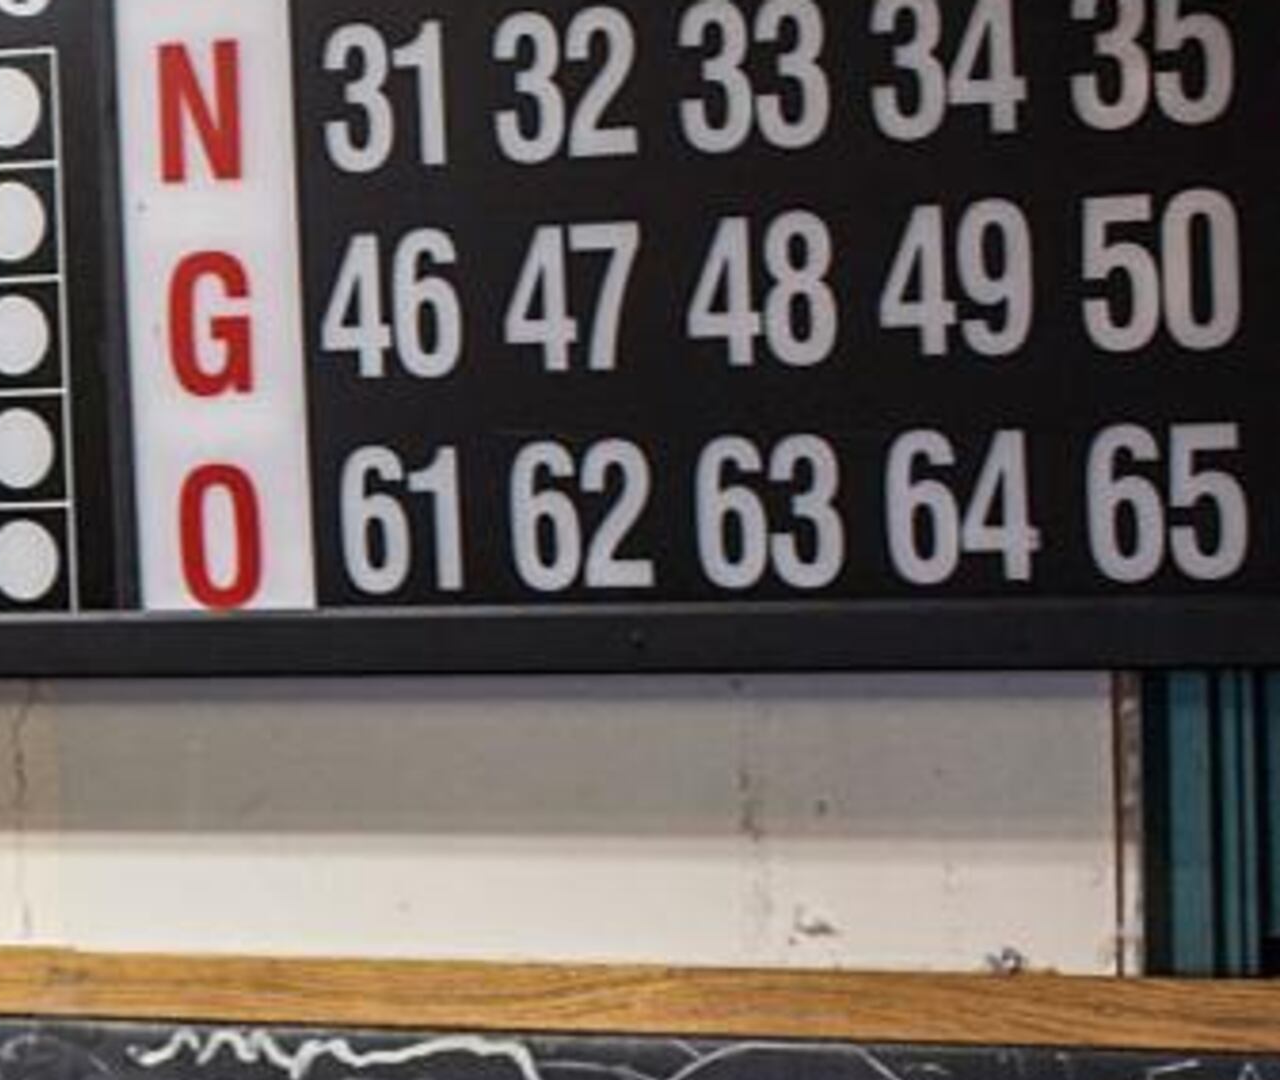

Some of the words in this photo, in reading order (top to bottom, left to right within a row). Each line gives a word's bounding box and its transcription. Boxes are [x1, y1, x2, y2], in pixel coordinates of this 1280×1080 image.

[158, 41, 241, 183] N
[322, 20, 447, 173] 31
[492, 6, 639, 164] 32
[679, 0, 830, 153] 33
[871, 0, 1027, 140] 34
[1071, 0, 1233, 130] 35
[167, 251, 253, 397] G
[320, 228, 463, 378] 46
[504, 221, 640, 371] 47
[687, 210, 837, 366] 48
[879, 199, 1033, 356] 49
[1082, 188, 1241, 352] 50
[179, 462, 262, 612] O
[339, 446, 464, 594] 61
[510, 438, 655, 592] 62
[696, 434, 844, 589] 63
[886, 429, 1040, 584] 64
[1087, 423, 1247, 581] 65
